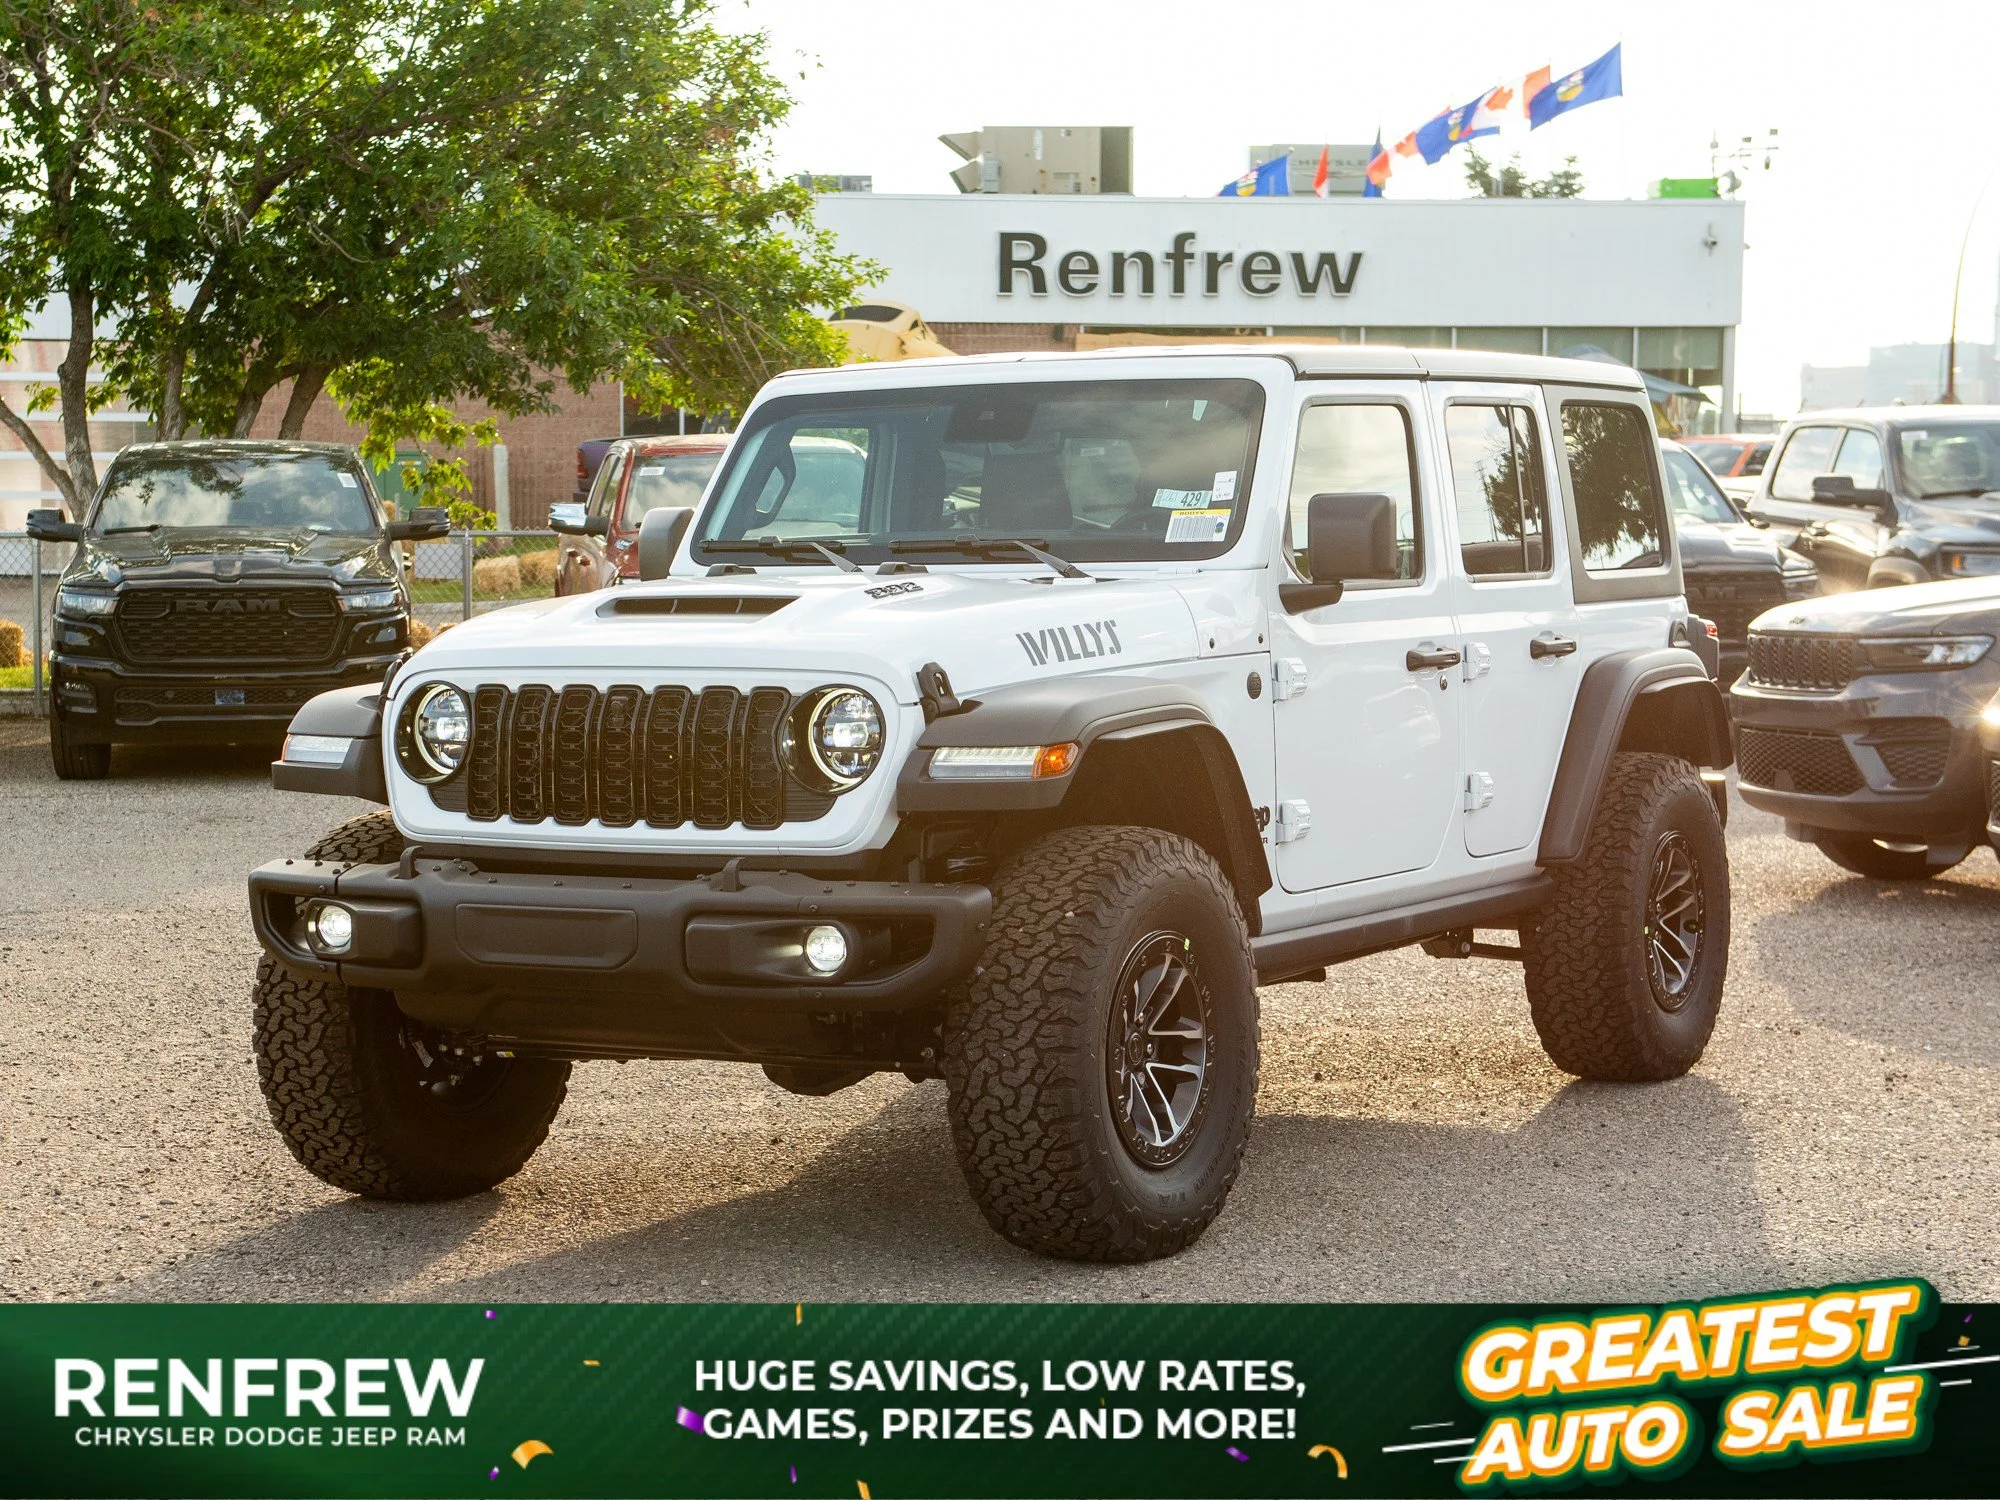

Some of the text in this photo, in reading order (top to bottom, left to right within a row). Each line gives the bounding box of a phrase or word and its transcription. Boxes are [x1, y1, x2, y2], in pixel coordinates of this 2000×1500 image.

[998, 231, 1365, 296] Renfrew
[1181, 492, 1202, 507] 429
[176, 599, 280, 612] RAM
[1016, 620, 1122, 666] WILLYS
